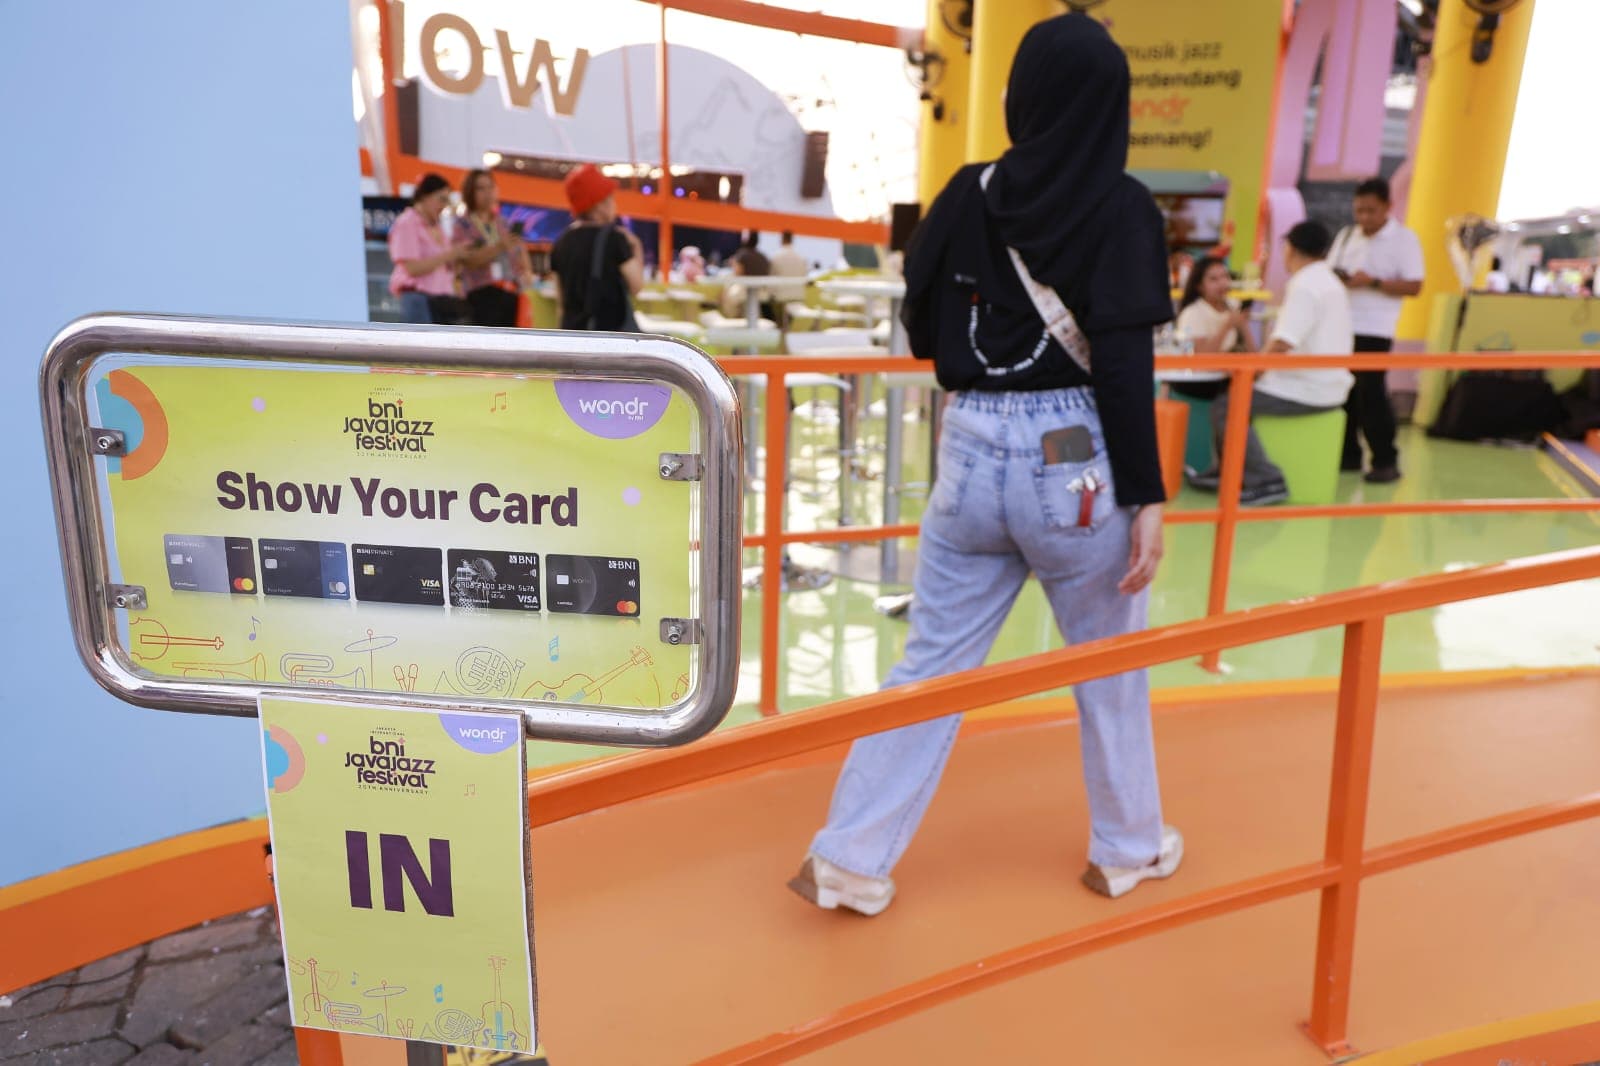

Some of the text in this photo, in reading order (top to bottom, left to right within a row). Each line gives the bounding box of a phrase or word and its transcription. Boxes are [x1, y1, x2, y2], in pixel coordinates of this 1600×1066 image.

[368, 398, 404, 418] bni
[578, 397, 649, 415] wondr
[343, 416, 435, 436] javajazz
[356, 433, 427, 452] festival
[215, 470, 579, 528] Show Your Card
[518, 555, 537, 565] BNI
[618, 560, 636, 570] BNI
[420, 579, 441, 588] VISA
[516, 594, 539, 604] VISA
[459, 727, 507, 740] wondr
[369, 735, 406, 757] bni
[344, 751, 436, 774] javajazz
[357, 767, 428, 789] festival
[345, 830, 455, 917] IN
